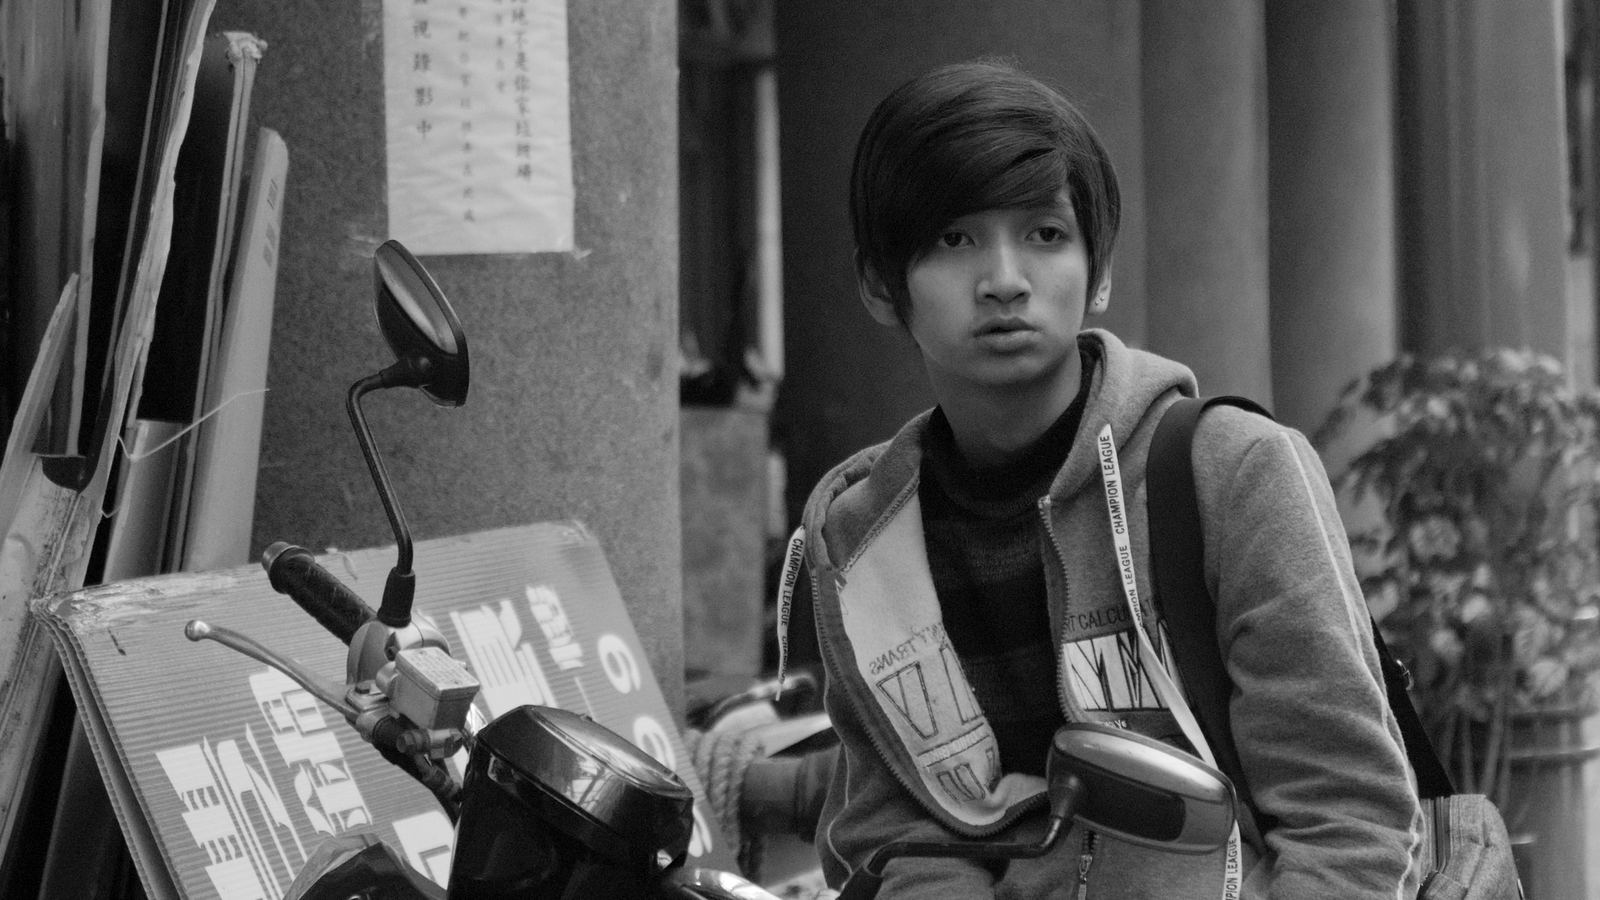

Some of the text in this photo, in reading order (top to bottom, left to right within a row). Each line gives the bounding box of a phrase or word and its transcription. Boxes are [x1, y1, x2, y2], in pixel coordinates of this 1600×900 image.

[1100, 435, 1116, 476] LEAGUE
[1105, 480, 1125, 534] CHAMPION
[784, 538, 803, 592] CHAMPION
[1120, 545, 1134, 585] LEAGUE
[781, 588, 792, 627] LEAGUE
[1227, 838, 1238, 874] LEAGUE
